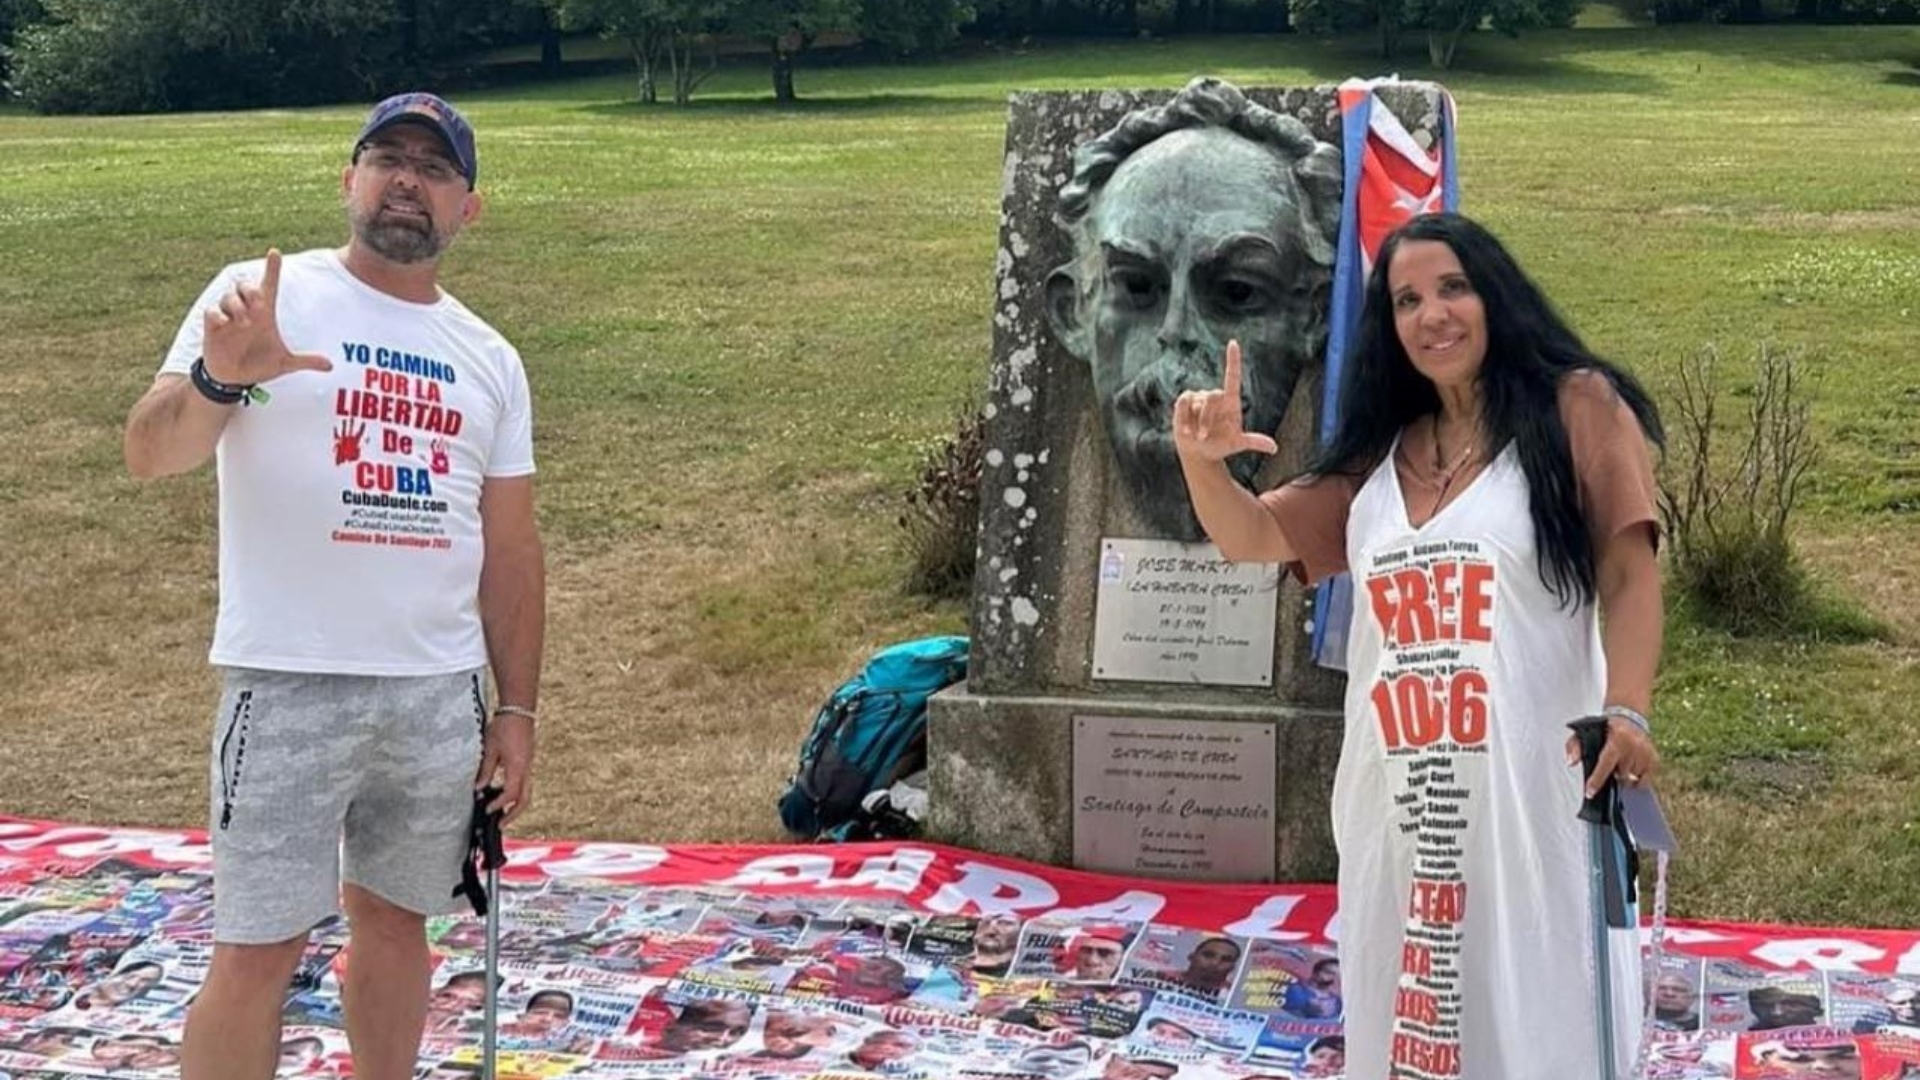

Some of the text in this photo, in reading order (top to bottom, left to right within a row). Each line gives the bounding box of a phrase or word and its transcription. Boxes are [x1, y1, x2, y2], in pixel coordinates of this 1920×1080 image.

[342, 342, 456, 384] YO CAMINO
[365, 368, 441, 402] POR LA
[336, 388, 463, 436] LIBERTAD
[383, 429, 413, 455] De
[356, 461, 433, 496] CUBA
[342, 490, 448, 513] CubaDuele.com
[332, 530, 373, 545] Camino
[390, 535, 431, 549] Santiago
[1366, 562, 1494, 646] FREE
[1079, 795, 1270, 821] Santiago de Compostela
[884, 1005, 982, 1032] Libertad
